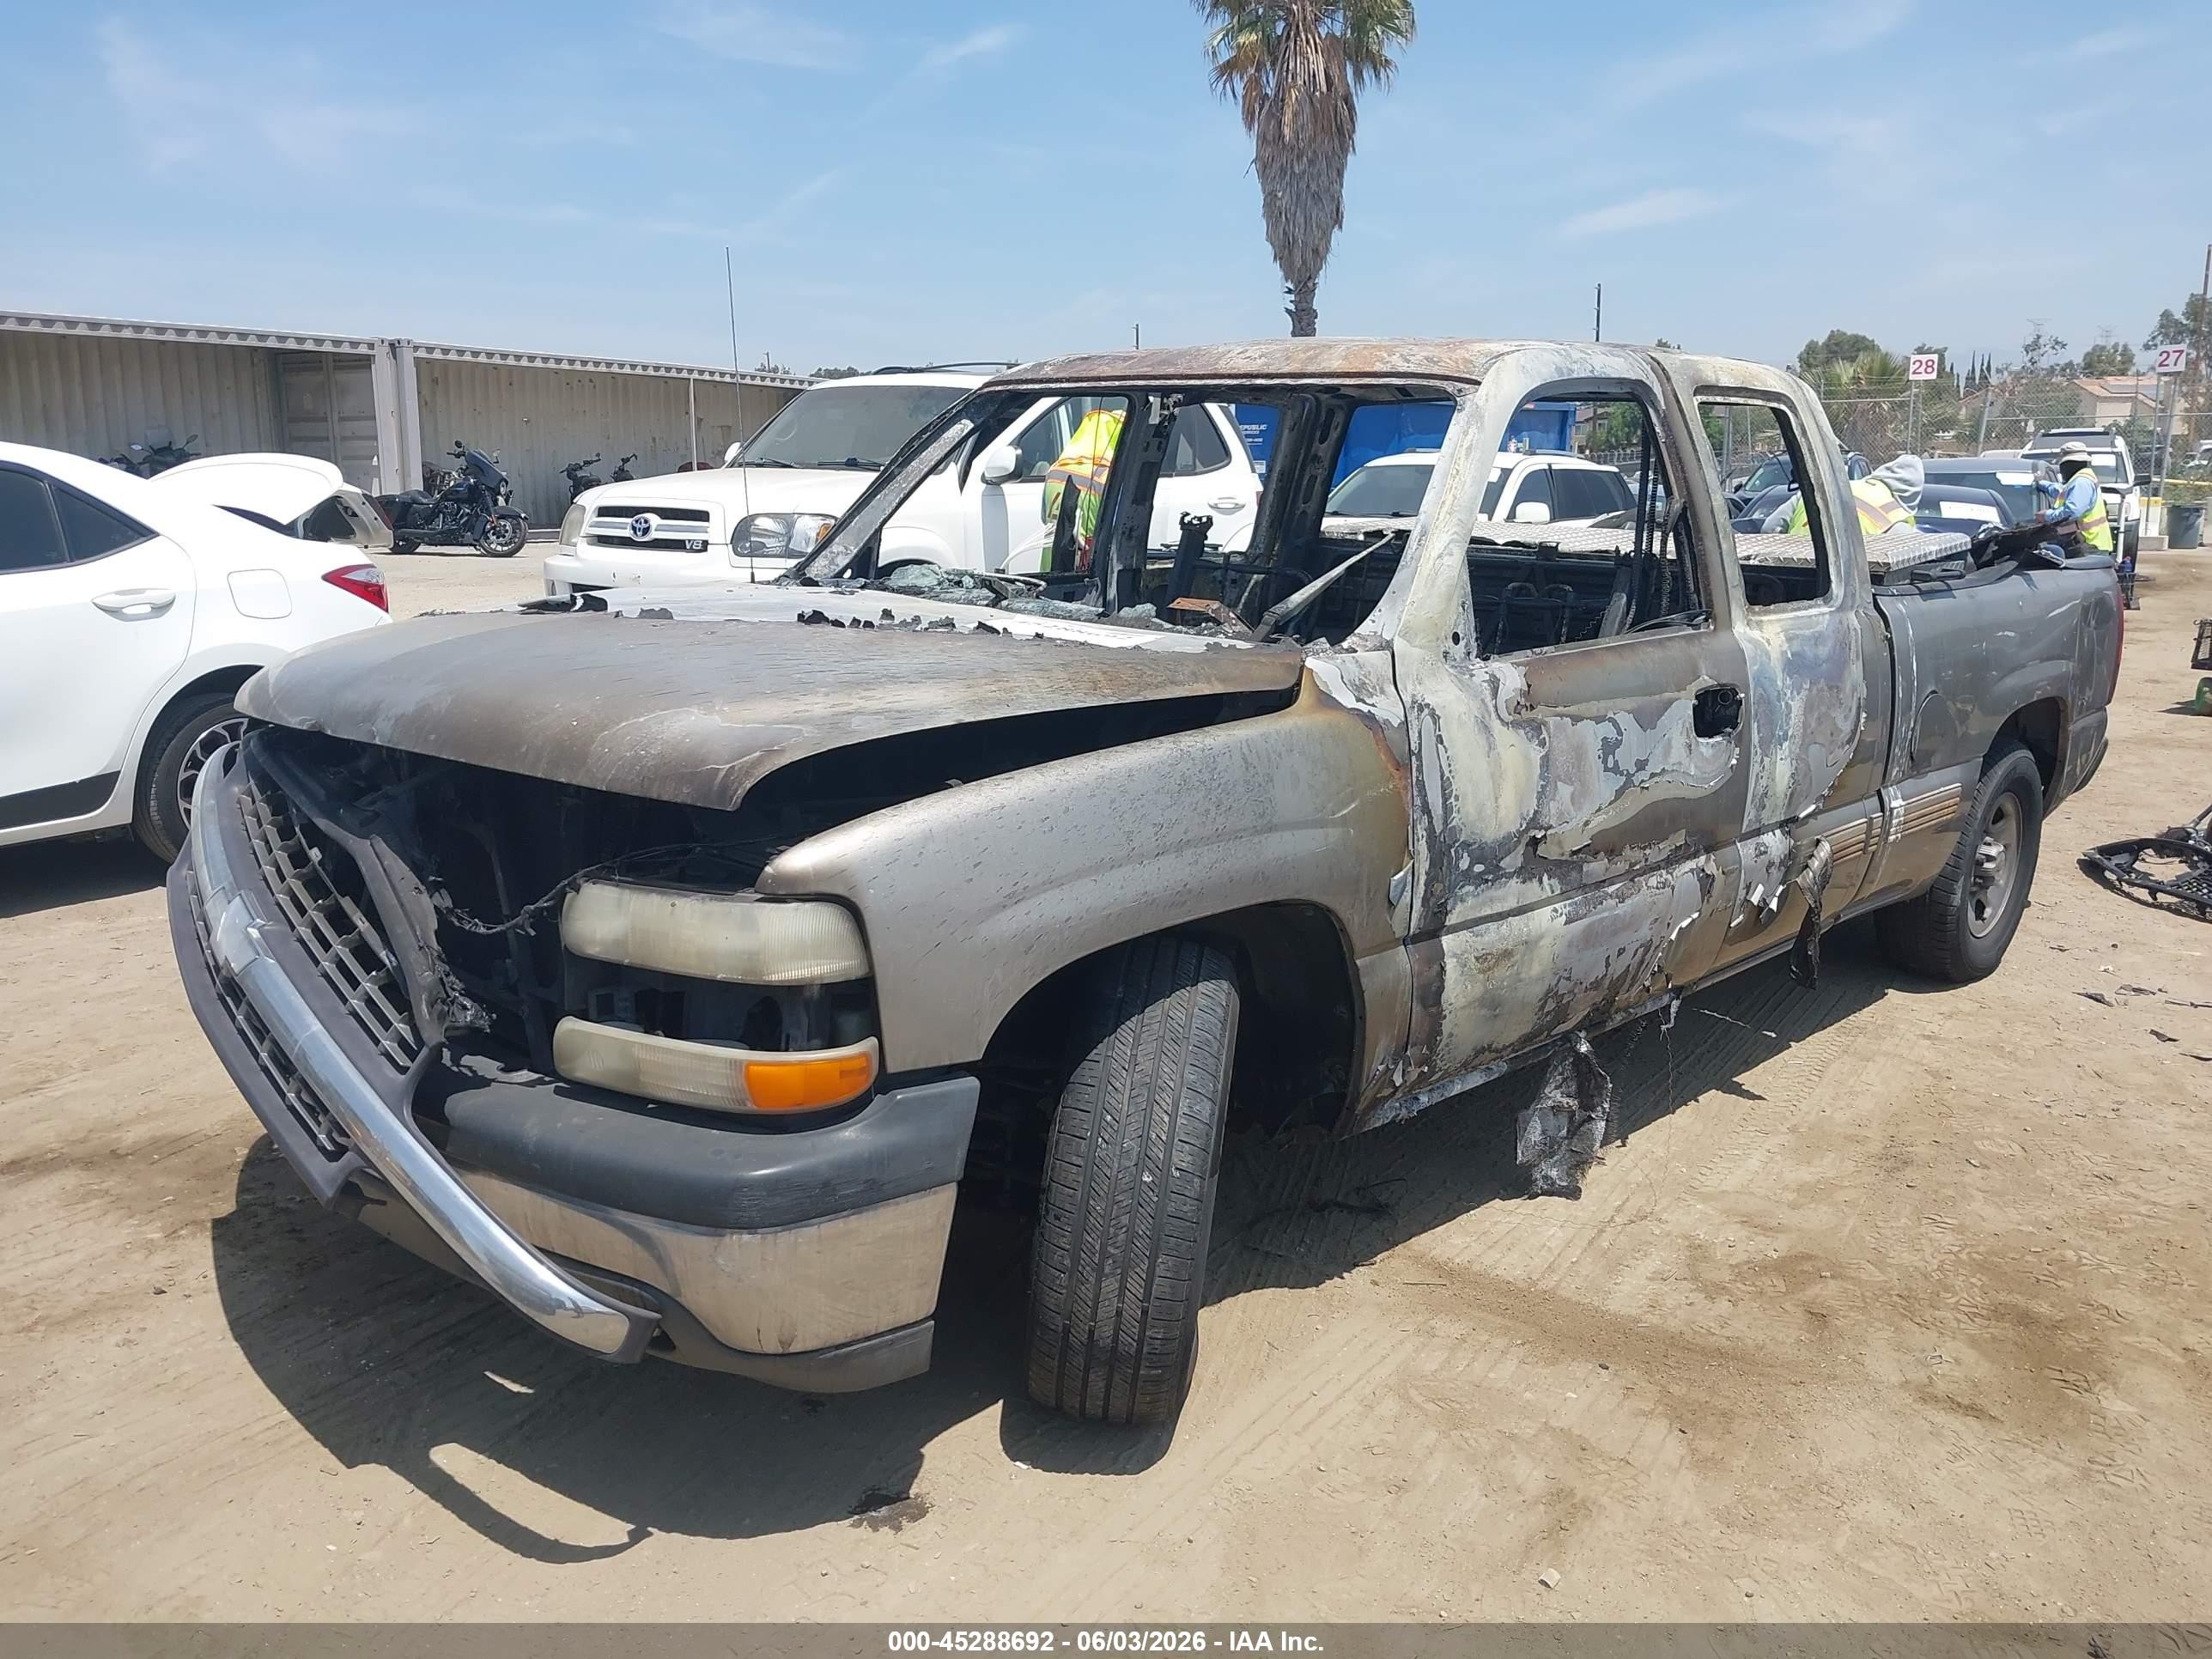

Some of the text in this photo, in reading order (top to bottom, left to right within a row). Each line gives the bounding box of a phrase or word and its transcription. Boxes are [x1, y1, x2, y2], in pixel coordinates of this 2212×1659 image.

[2157, 349, 2185, 368] 27
[1911, 359, 1936, 375] 28
[685, 539, 702, 550] V8
